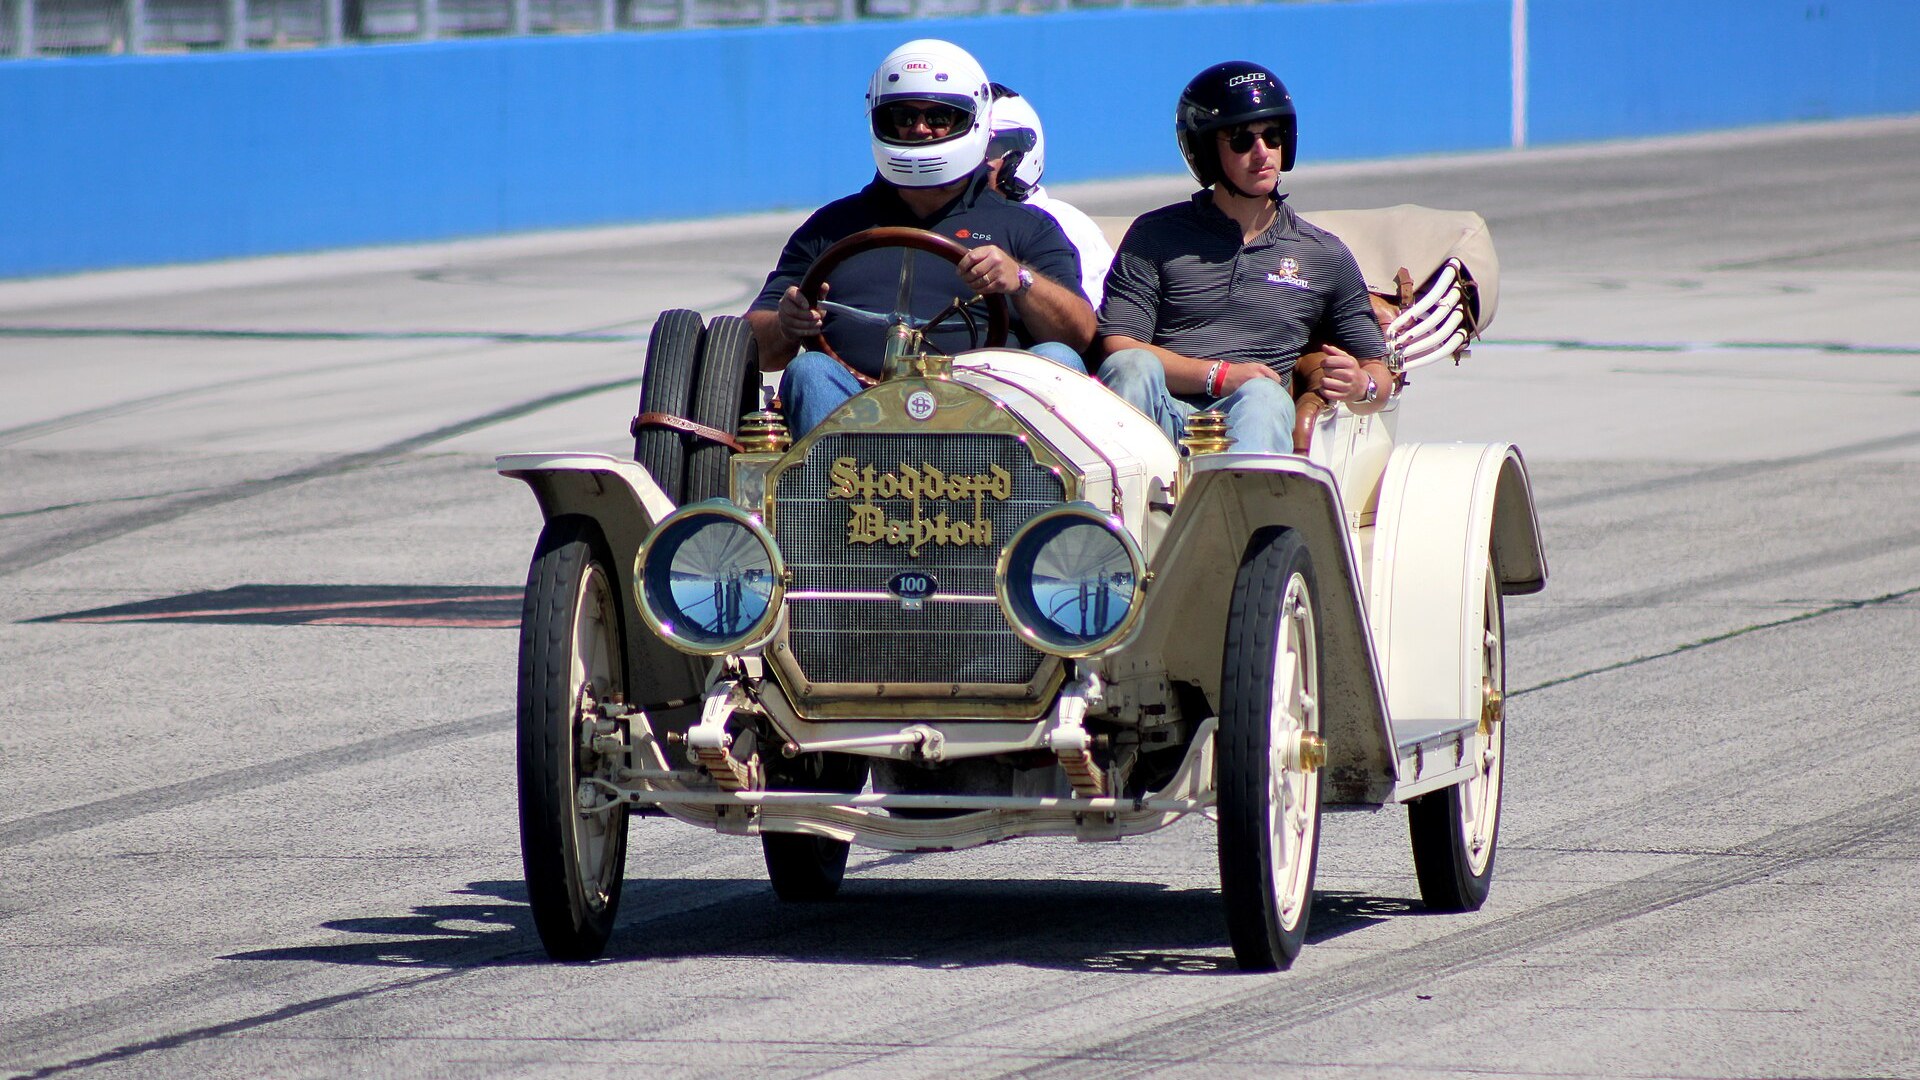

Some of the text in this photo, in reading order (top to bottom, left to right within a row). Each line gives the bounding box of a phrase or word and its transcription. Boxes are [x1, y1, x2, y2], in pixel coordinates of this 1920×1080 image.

[971, 232, 992, 241] CPS
[827, 456, 1011, 501] Stoddard
[848, 503, 992, 558] Dayton
[900, 577, 927, 592] 100
